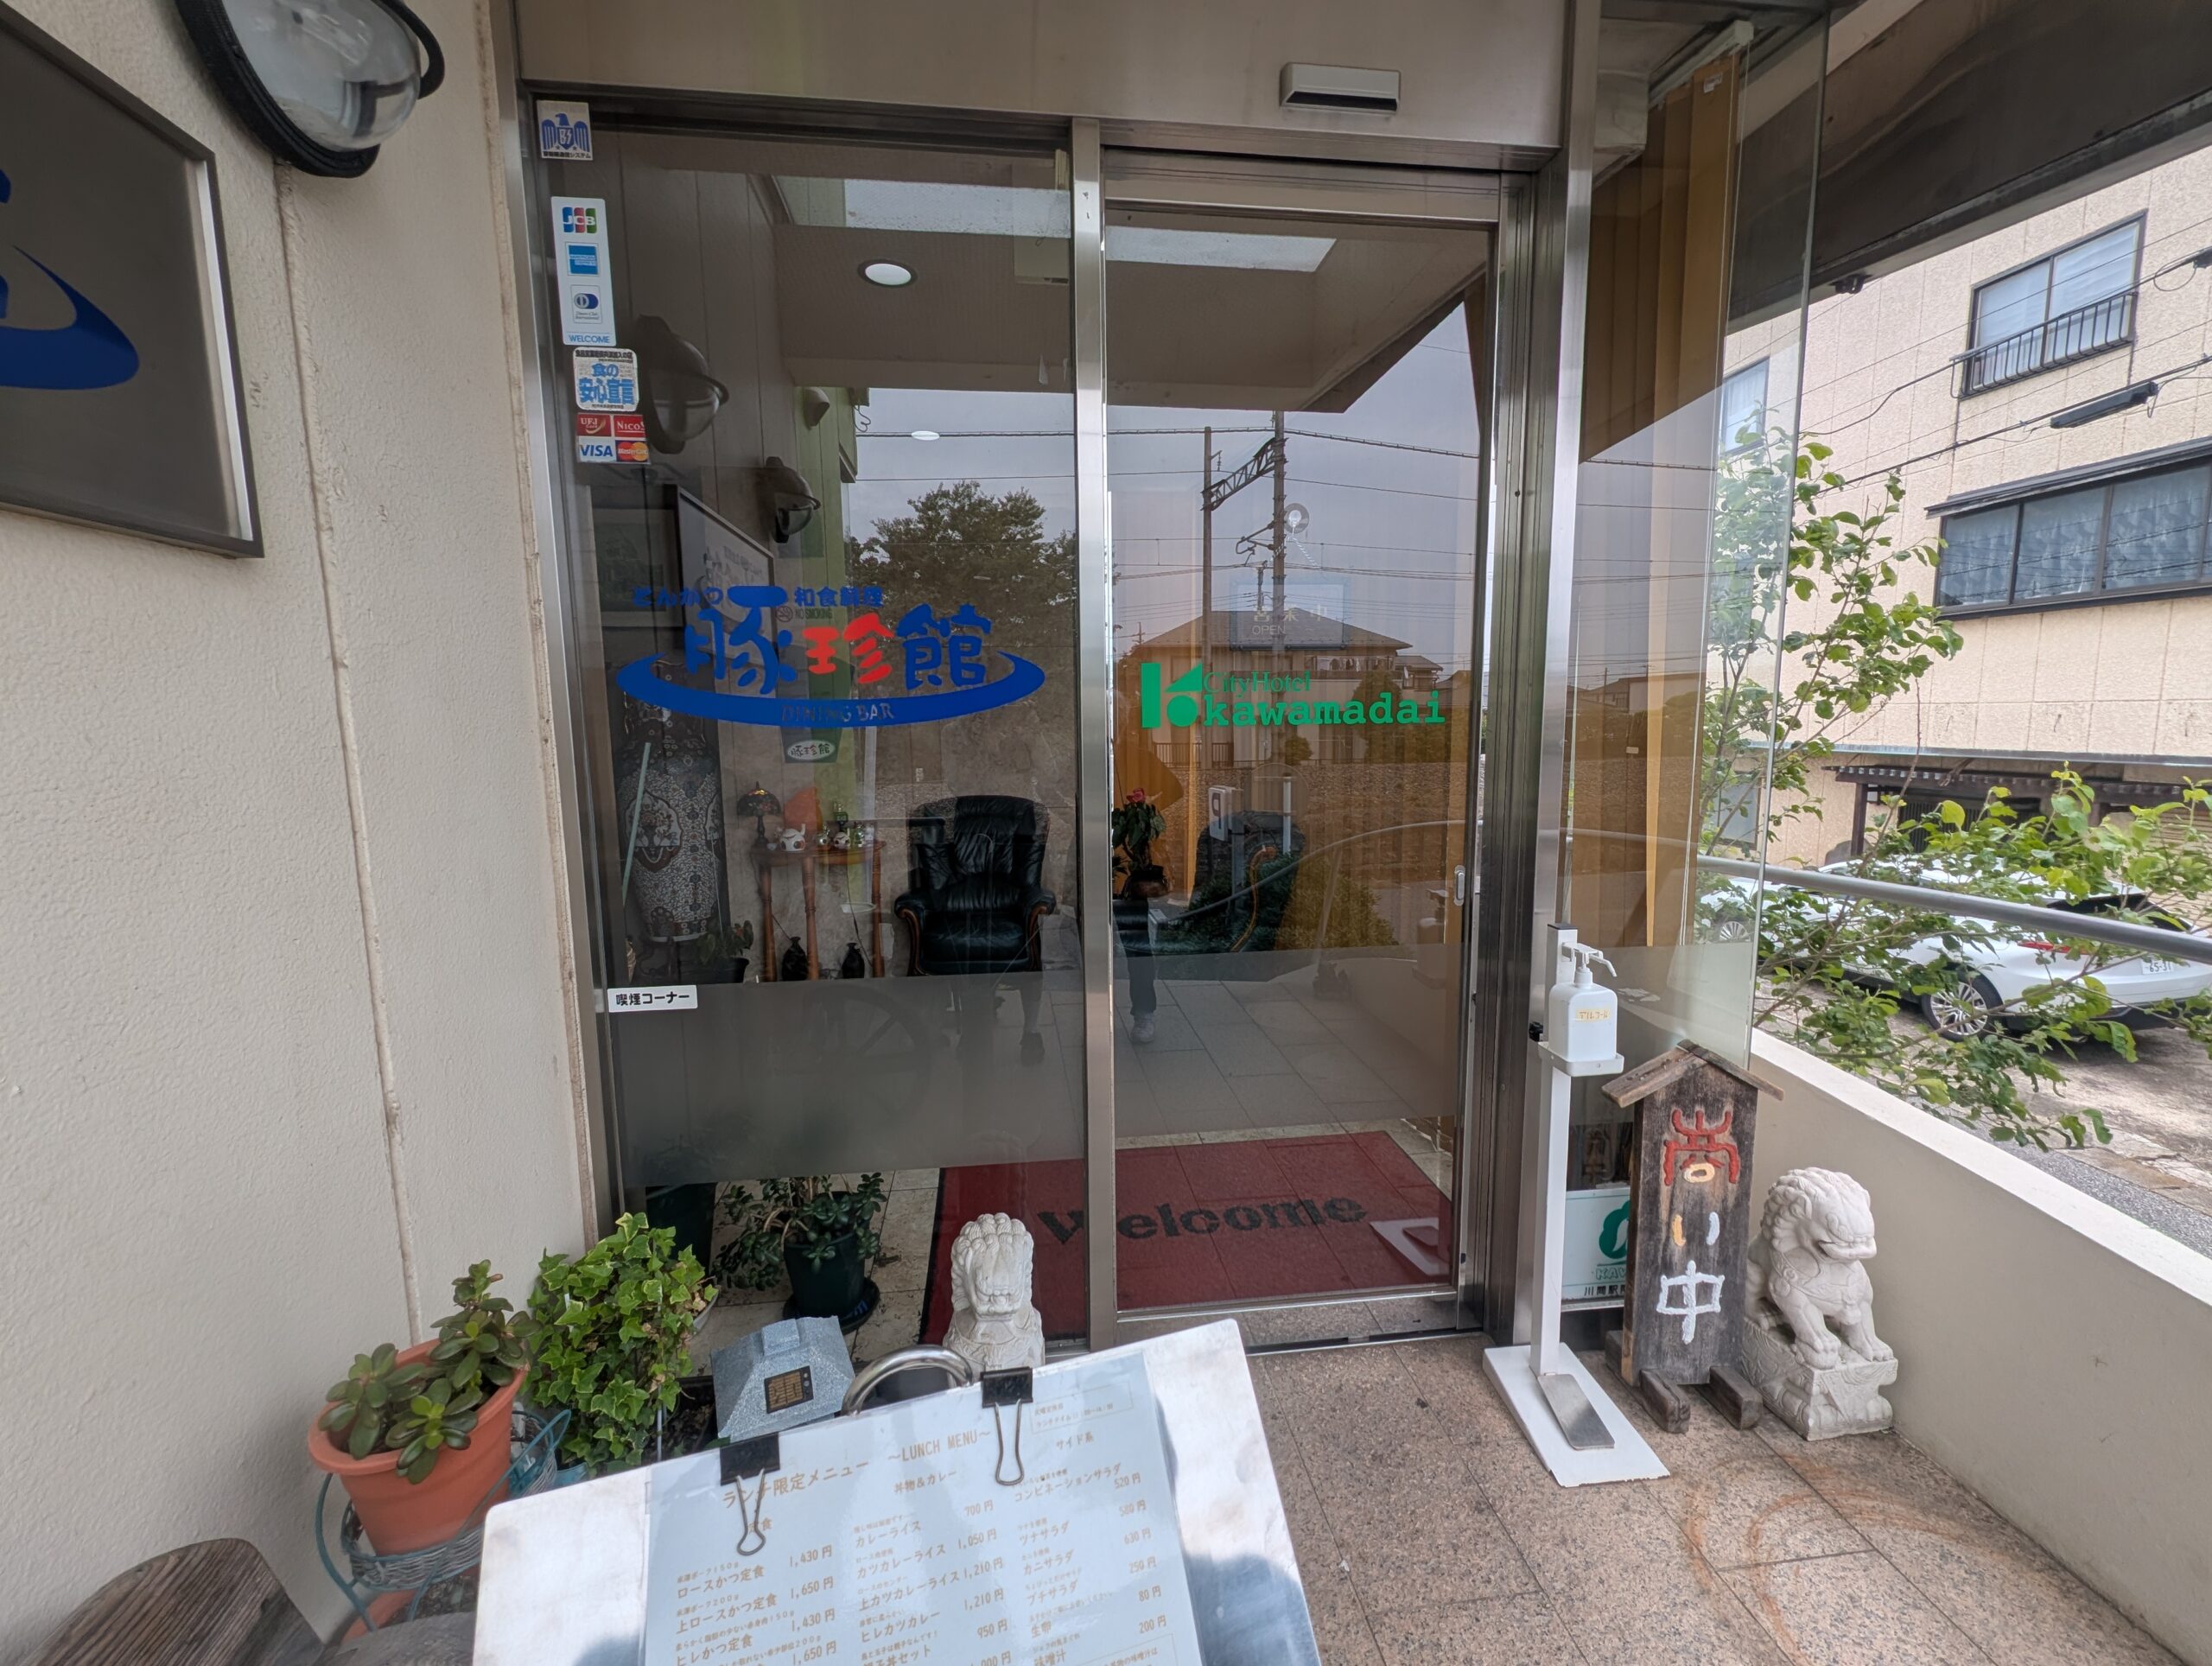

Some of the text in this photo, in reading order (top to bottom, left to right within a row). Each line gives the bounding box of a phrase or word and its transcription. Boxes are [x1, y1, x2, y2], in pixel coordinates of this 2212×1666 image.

[563, 215, 596, 226] JCB
[569, 334, 610, 344] WELCOME
[592, 363, 620, 378] 食の
[579, 378, 636, 405] 安心宣言
[580, 444, 613, 457] VISA
[632, 586, 723, 607] とんかつ
[684, 584, 992, 695] 豚珍館
[1251, 625, 1287, 635] OPEN
[780, 702, 894, 723] DINING BAR
[1202, 690, 1446, 728] kawamadai
[615, 990, 691, 1007] 喫煙コーナー
[723, 1463, 868, 1508] ランチ限定メニュー
[1014, 1463, 1121, 1501] コンビネーションサラダ
[856, 1521, 921, 1548] カレーライス
[1020, 1520, 1069, 1546] ツナサラダ
[857, 1544, 945, 1580] カツカレーライス
[1022, 1549, 1074, 1575] カニサラダ
[677, 1565, 764, 1599] ロースかつ定食
[859, 1571, 960, 1612] 上カツカレーライス
[1027, 1578, 1078, 1606] プチサラダ
[677, 1593, 777, 1634] 上ロースかつ定食
[861, 1612, 940, 1643] ヒレカツカレー
[676, 1634, 752, 1666] ヒレかつ定食
